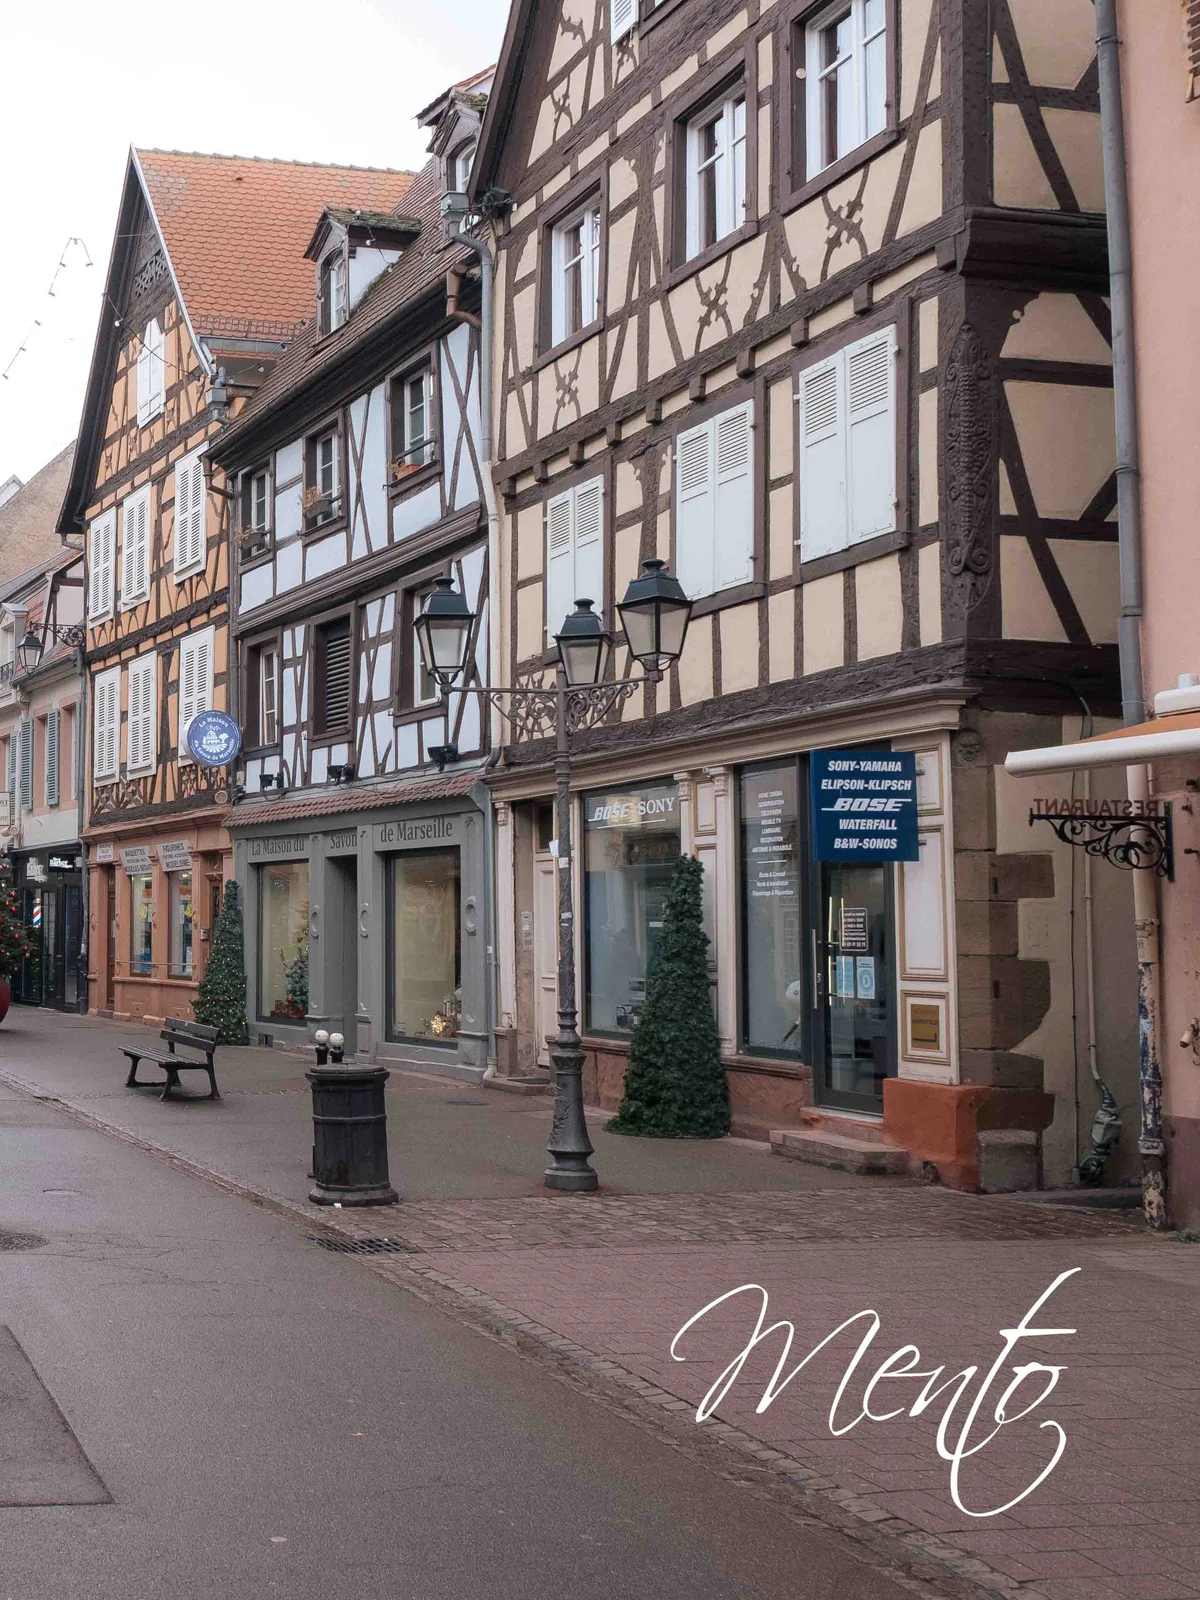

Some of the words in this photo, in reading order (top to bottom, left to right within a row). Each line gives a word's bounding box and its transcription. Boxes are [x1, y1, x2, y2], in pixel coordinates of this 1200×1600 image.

[199, 720, 206, 728] La
[206, 717, 229, 728] Maison
[827, 760, 902, 772] SONY-YAMAHA
[821, 779, 912, 791] ELIPSON-KLIPSCH
[589, 803, 630, 821] BOSE
[637, 797, 676, 816] SONY
[821, 798, 912, 811] BOSE
[839, 819, 897, 830] WATERFALL
[252, 841, 261, 856] La
[262, 839, 292, 855] Maison
[293, 838, 305, 852] du
[330, 832, 358, 849] Savon
[380, 824, 394, 843] de
[397, 816, 453, 841] Marseille
[833, 838, 898, 849] B&W-SONOS
